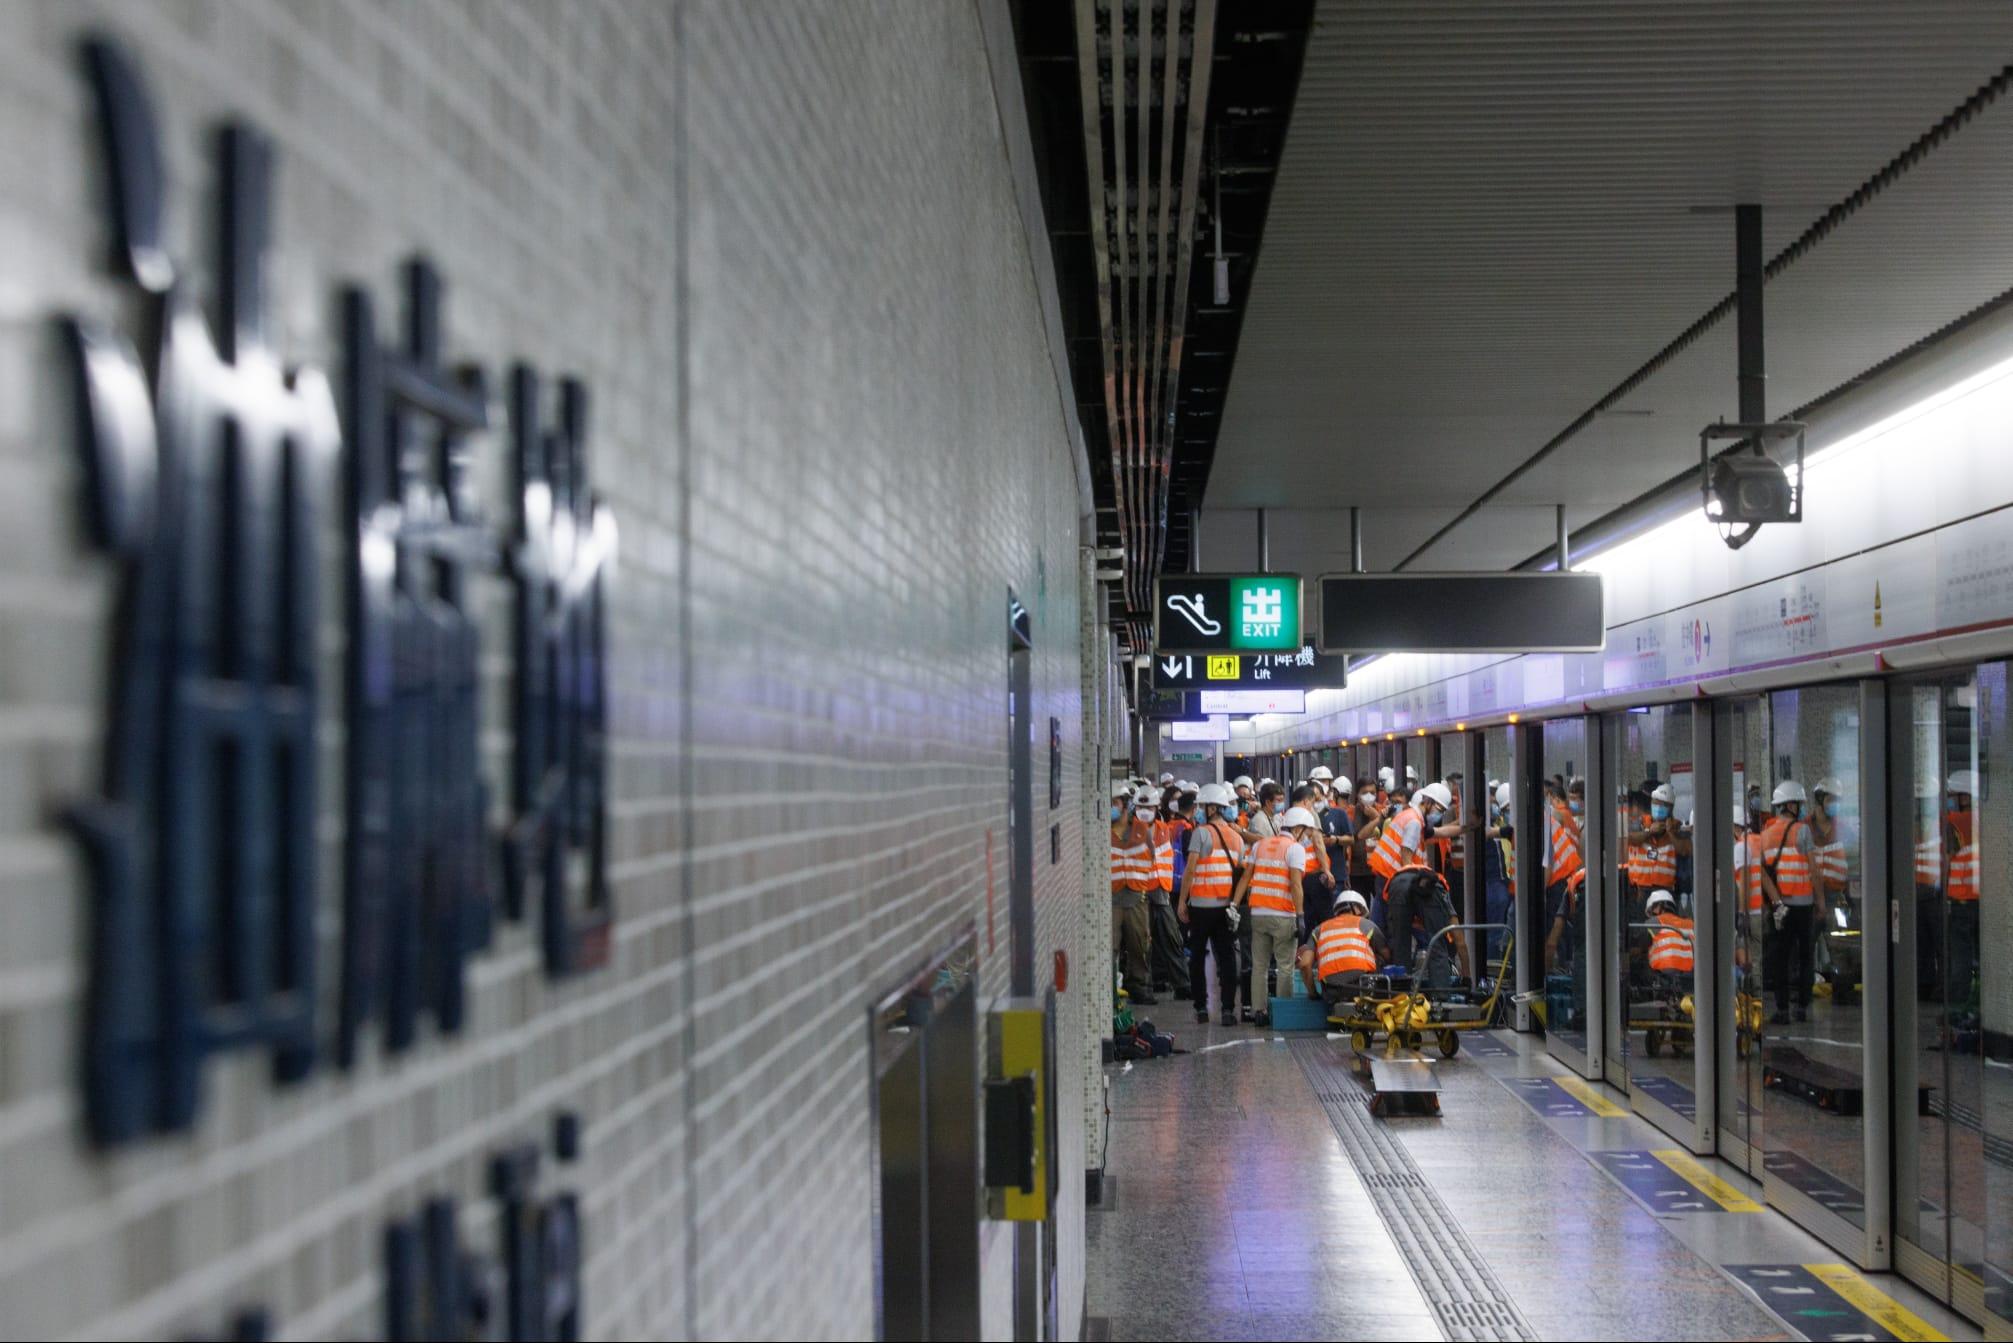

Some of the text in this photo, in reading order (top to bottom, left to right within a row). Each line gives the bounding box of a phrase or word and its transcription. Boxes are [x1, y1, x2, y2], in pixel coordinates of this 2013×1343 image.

[1242, 588, 1282, 622] 出
[1242, 623, 1282, 637] EXIT
[1254, 669, 1271, 680] Lift
